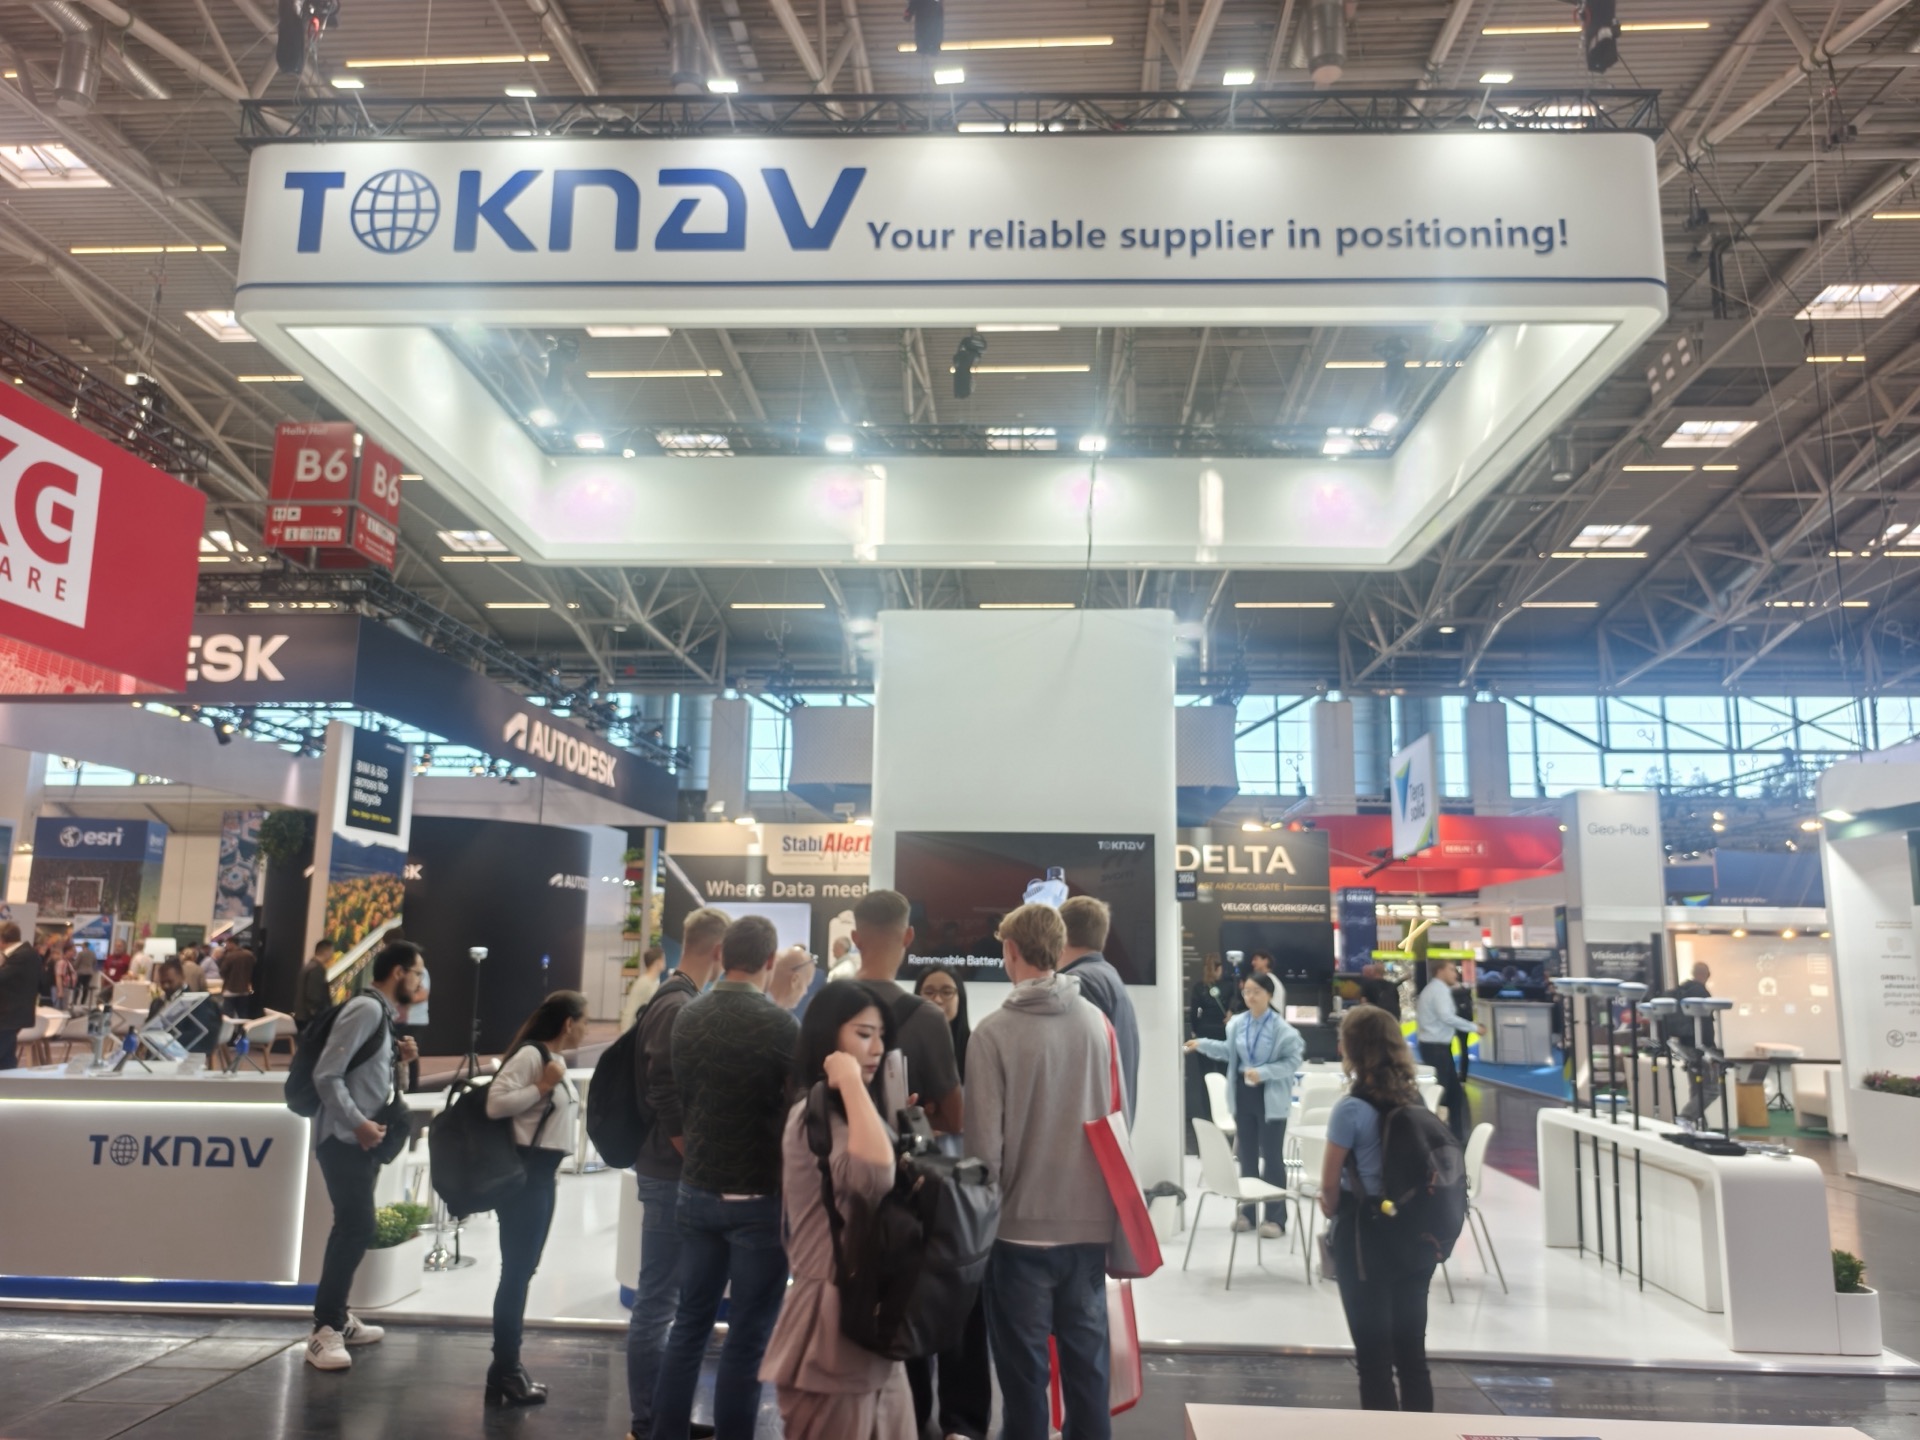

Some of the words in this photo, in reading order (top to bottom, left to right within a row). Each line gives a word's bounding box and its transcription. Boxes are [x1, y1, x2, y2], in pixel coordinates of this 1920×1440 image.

[867, 221, 955, 251] Your
[969, 218, 1107, 251] reliable
[1119, 218, 1274, 257] supplier
[1288, 218, 1321, 249] in
[1335, 217, 1569, 257] positioning!
[296, 449, 348, 482] B6
[373, 462, 399, 506] B6
[527, 720, 617, 788] AUTODESK
[1409, 782, 1425, 802] Terra
[1410, 800, 1426, 822] solid
[84, 827, 123, 847] esri
[1587, 823, 1650, 836] Geo-Plus
[782, 832, 872, 853] StabiAlert
[1176, 845, 1296, 875] DELTA
[706, 880, 766, 898] Where
[772, 881, 816, 897] Data
[1215, 883, 1234, 891] AND
[1236, 882, 1280, 892] ACCURATE
[1222, 903, 1250, 912] VELOX
[1269, 904, 1327, 913] WORKSPACE
[908, 954, 966, 966] Removable
[967, 955, 1004, 967] Battery
